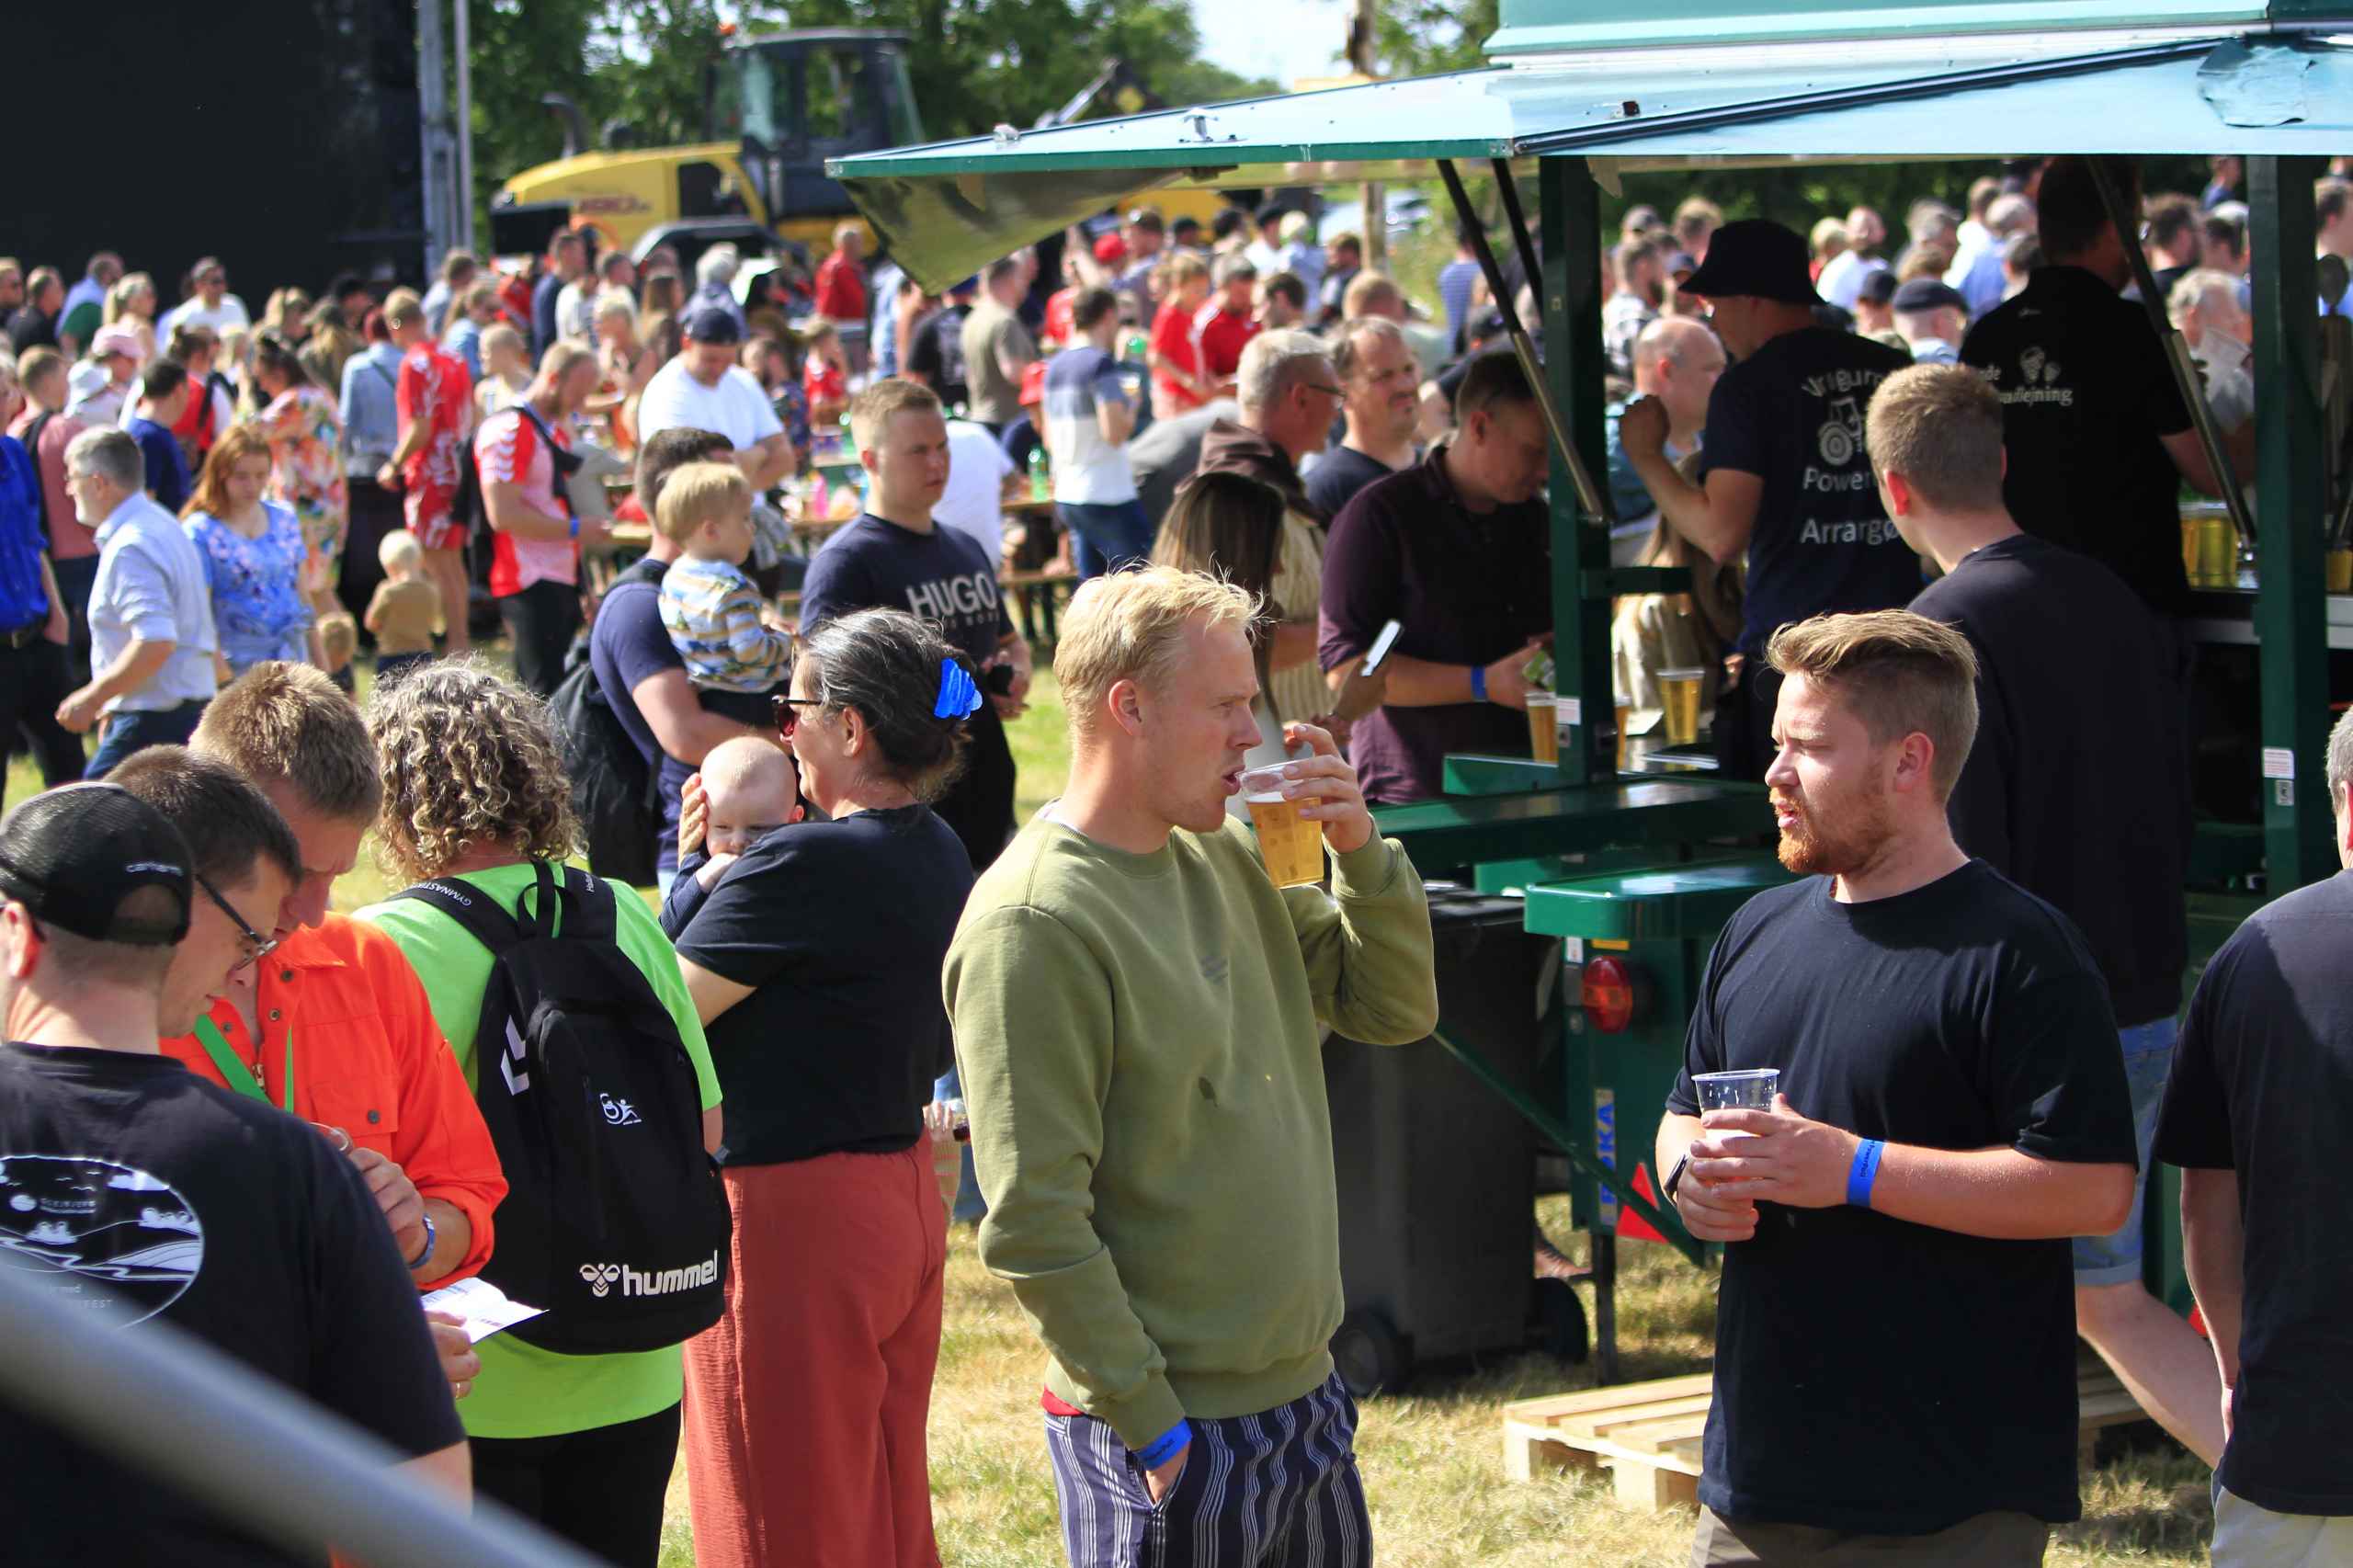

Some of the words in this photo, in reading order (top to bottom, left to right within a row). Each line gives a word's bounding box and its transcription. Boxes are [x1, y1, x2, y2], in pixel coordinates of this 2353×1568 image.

[905, 573, 996, 620] HUGO
[1597, 1103, 1617, 1204] FKA
[621, 1249, 718, 1297] hummel
